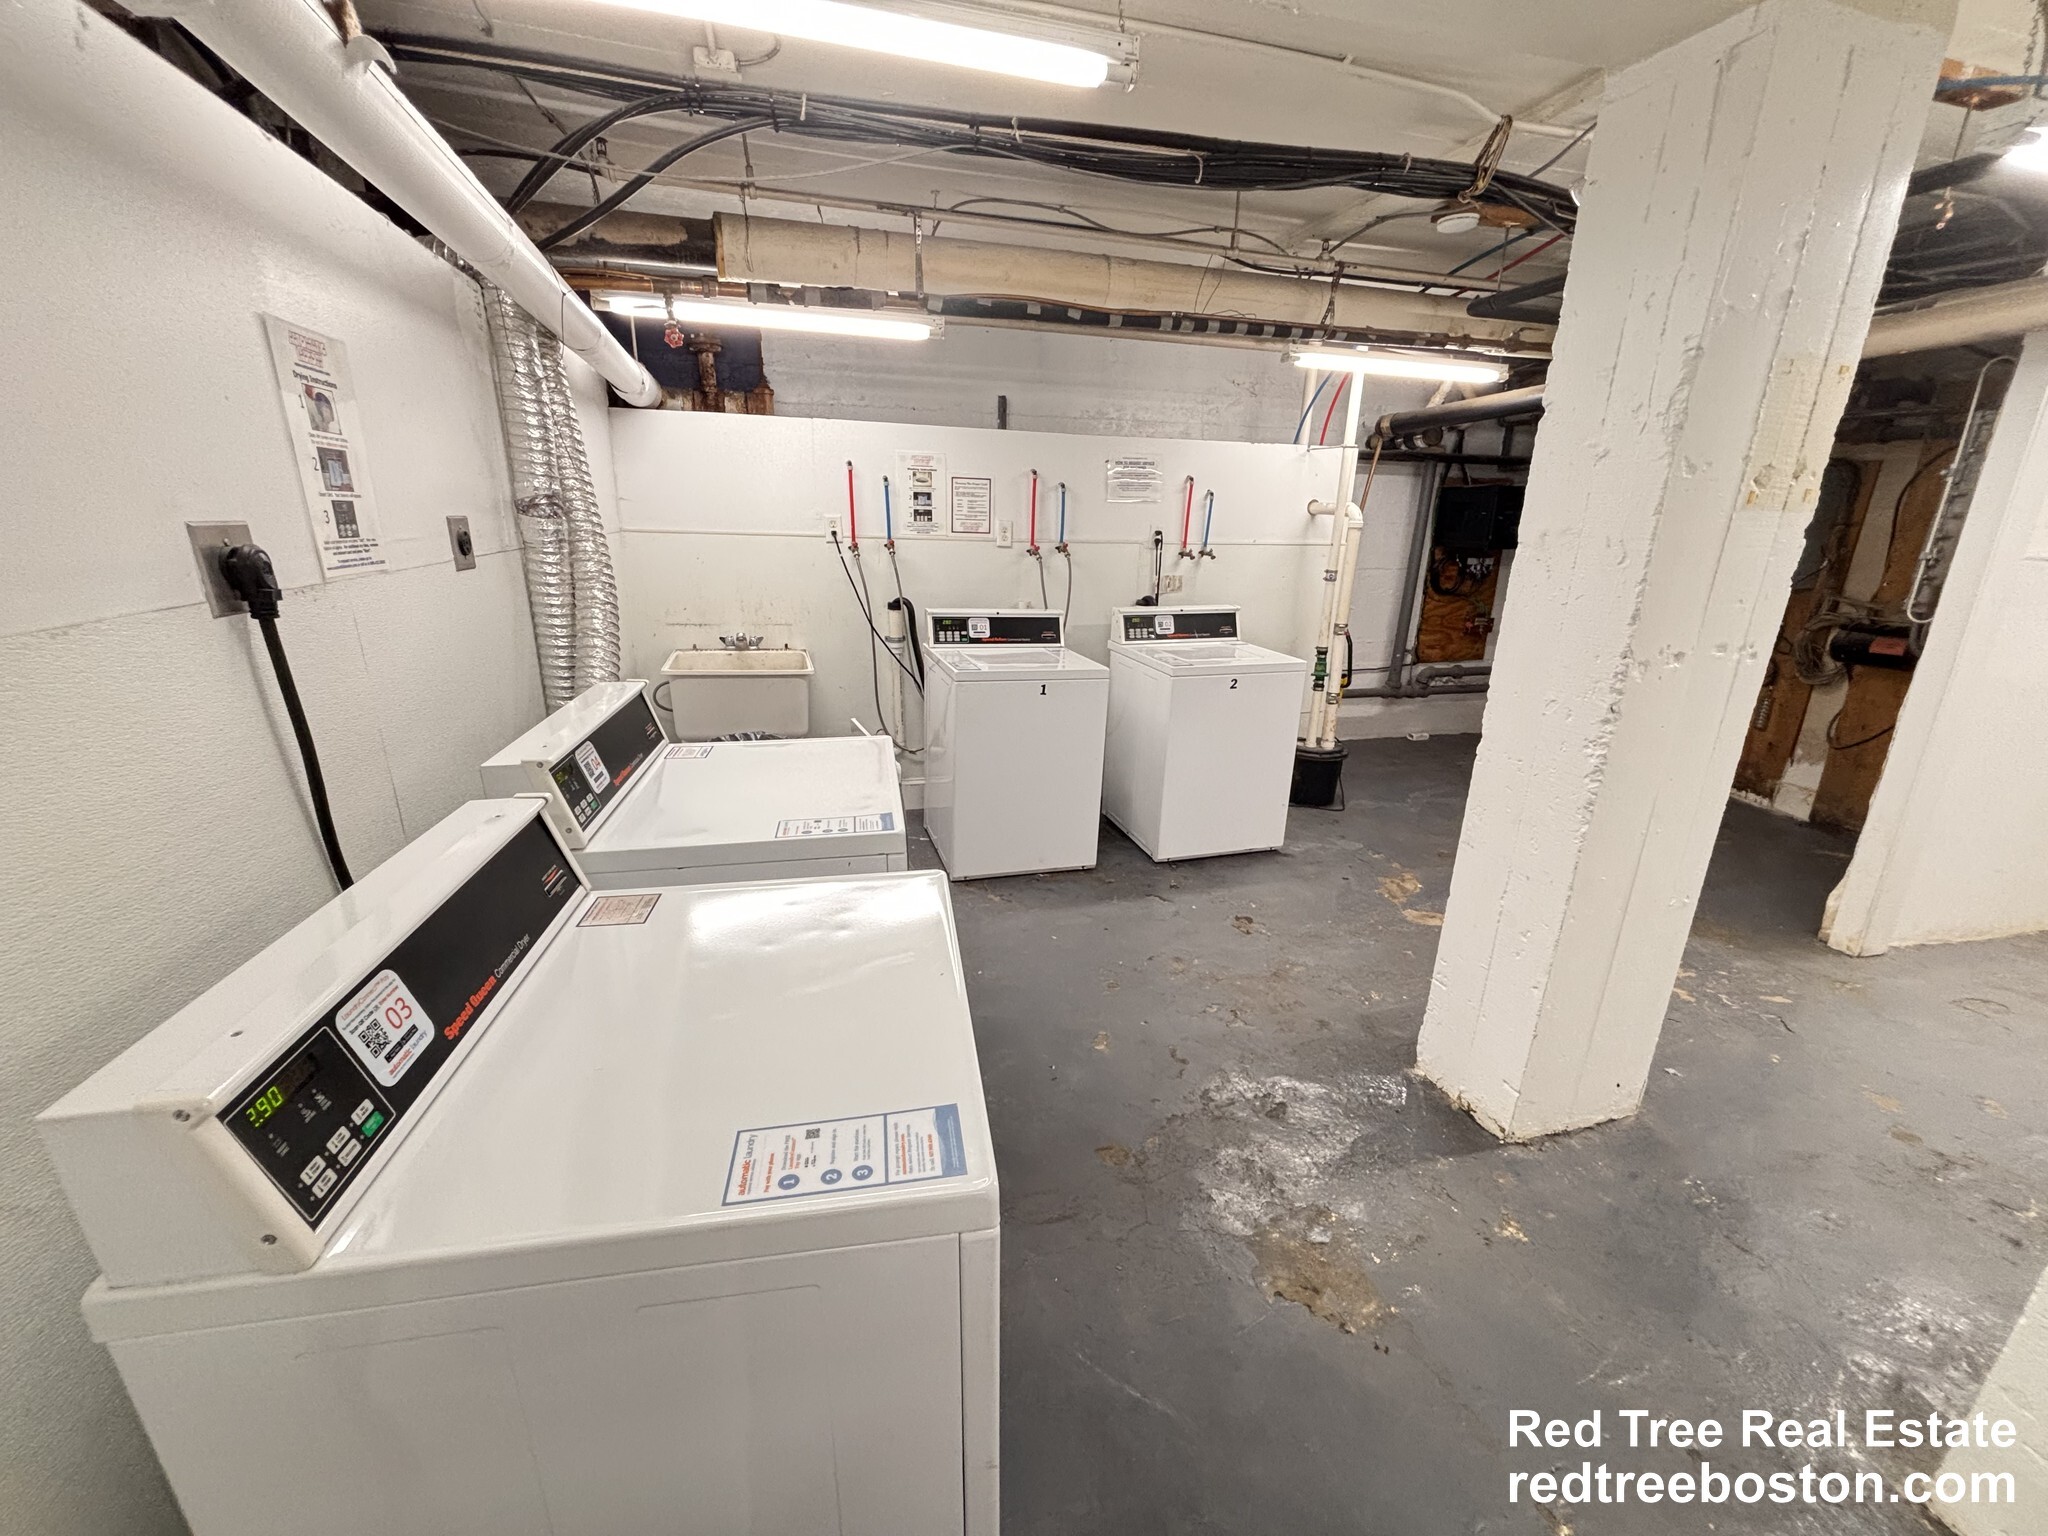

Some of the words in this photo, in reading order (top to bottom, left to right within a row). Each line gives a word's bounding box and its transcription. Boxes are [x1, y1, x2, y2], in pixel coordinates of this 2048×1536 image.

[298, 394, 305, 409] 1
[312, 457, 320, 472] 2
[323, 510, 330, 525] 3
[1039, 683, 1047, 696] 1
[1229, 677, 1238, 690] 2
[443, 1003, 474, 1041] Speed
[469, 974, 497, 1006] Queen
[494, 947, 521, 978] Commercial
[516, 933, 530, 950] Dryer
[384, 996, 413, 1030] 03
[743, 1134, 758, 1159] laundry
[737, 1159, 752, 1196] automatic
[825, 1172, 837, 1180] 2
[856, 1168, 868, 1176] 3
